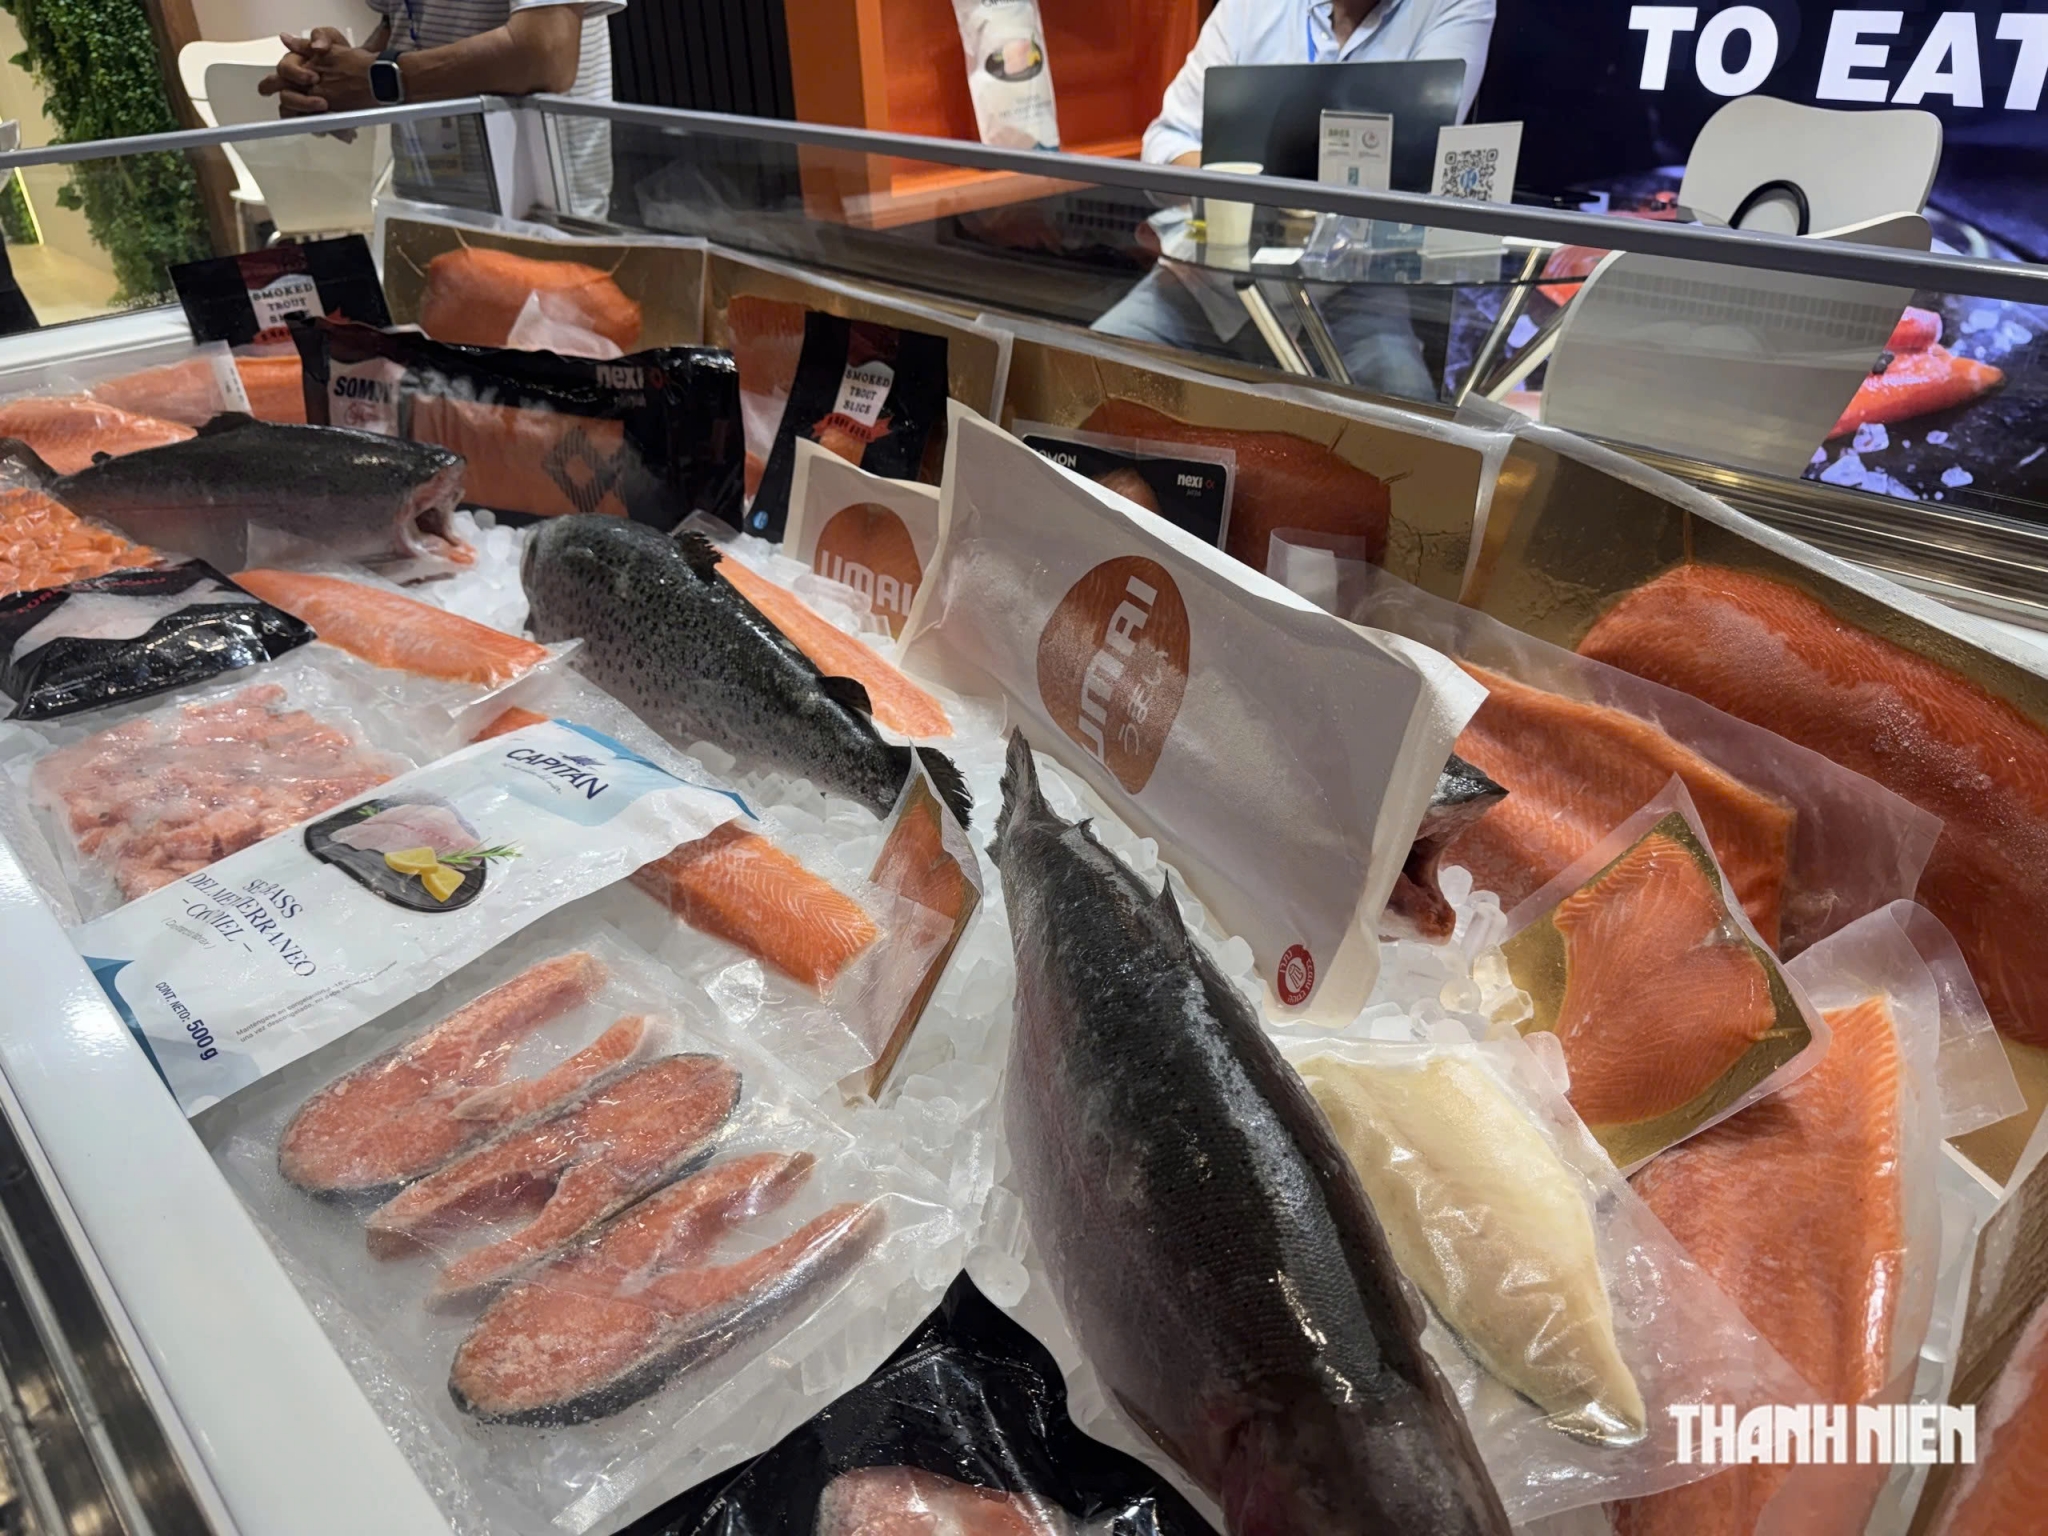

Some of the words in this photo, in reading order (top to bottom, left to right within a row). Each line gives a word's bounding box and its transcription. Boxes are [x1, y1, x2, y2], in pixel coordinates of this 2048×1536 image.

[1628, 5, 1779, 97] TO
[1816, 9, 2048, 111] EAT
[252, 283, 313, 300] SMOKED
[267, 298, 307, 312] TROUT
[845, 368, 891, 388] SMOKED
[849, 386, 878, 401] TROUT
[843, 400, 871, 414] SLICE
[1177, 473, 1204, 488] nexi
[1077, 574, 1158, 764] UMAI
[155, 981, 176, 1006] CONT.
[170, 1000, 191, 1022] NETO:
[187, 1019, 215, 1048] 500
[240, 1033, 253, 1043] una
[254, 1026, 267, 1035] vez
[200, 1046, 219, 1061] g
[702, 1496, 728, 1527] NET
